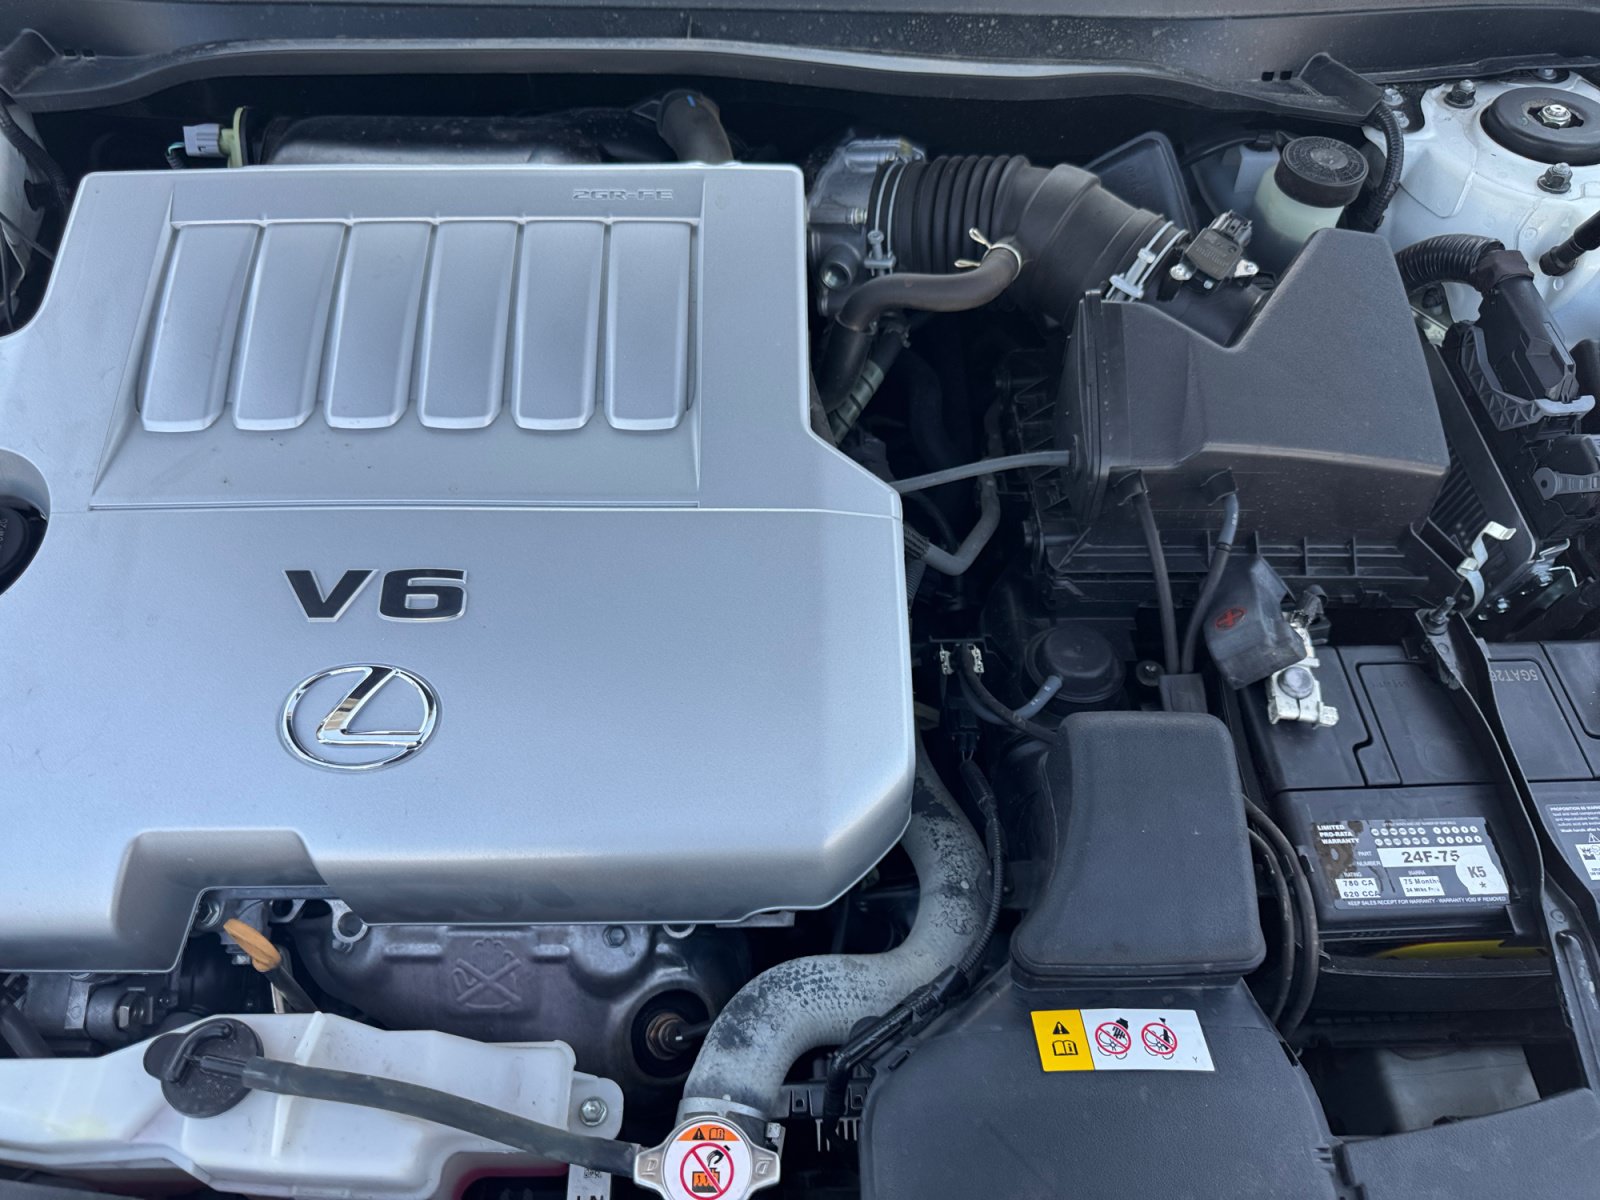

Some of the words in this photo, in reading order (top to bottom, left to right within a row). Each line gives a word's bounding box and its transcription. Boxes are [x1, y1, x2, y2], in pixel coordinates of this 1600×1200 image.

[572, 188, 673, 200] 2GR-FE
[282, 568, 467, 623] V6
[1401, 850, 1460, 863] 24F-75
[1467, 865, 1487, 878] K5
